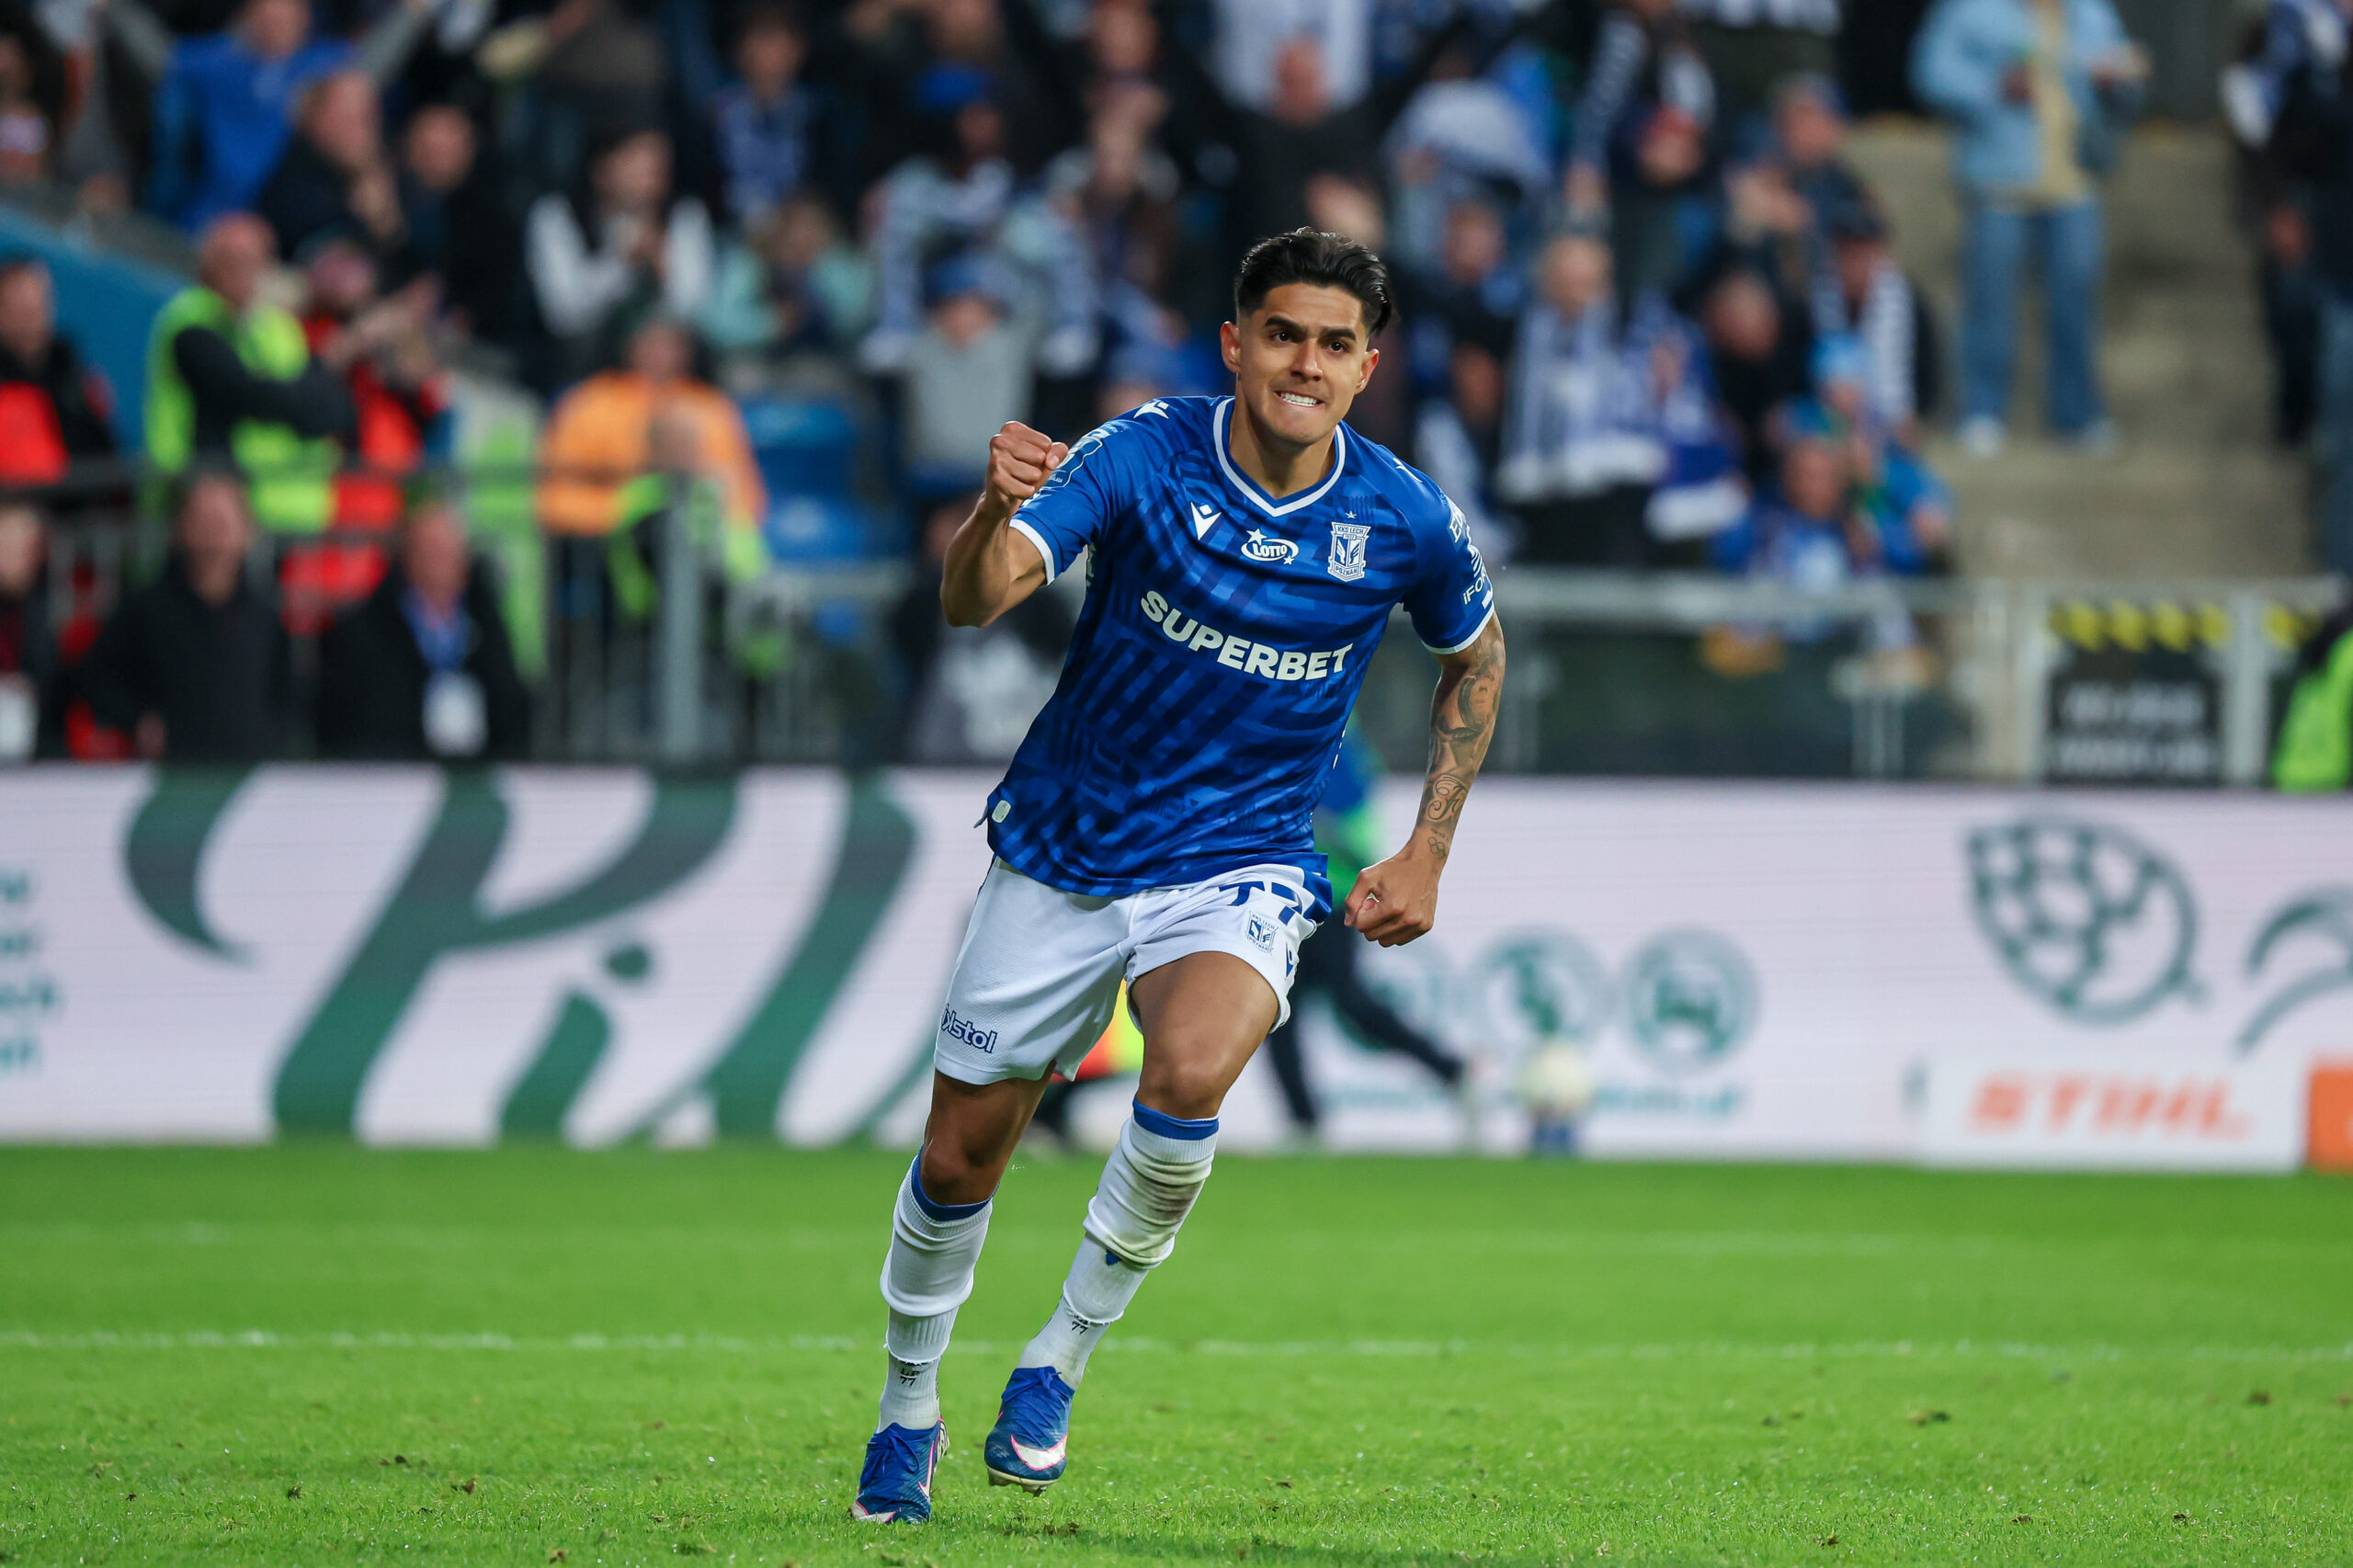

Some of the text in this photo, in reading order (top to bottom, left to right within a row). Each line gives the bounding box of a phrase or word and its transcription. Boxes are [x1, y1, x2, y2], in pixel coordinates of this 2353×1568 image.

[1349, 527, 1364, 535] LECH
[1252, 543, 1288, 557] LOTTO
[1141, 590, 1354, 681] SUPERBET
[1218, 881, 1303, 926] 77
[1072, 1321, 1088, 1335] 77
[900, 1376, 916, 1386] 77
